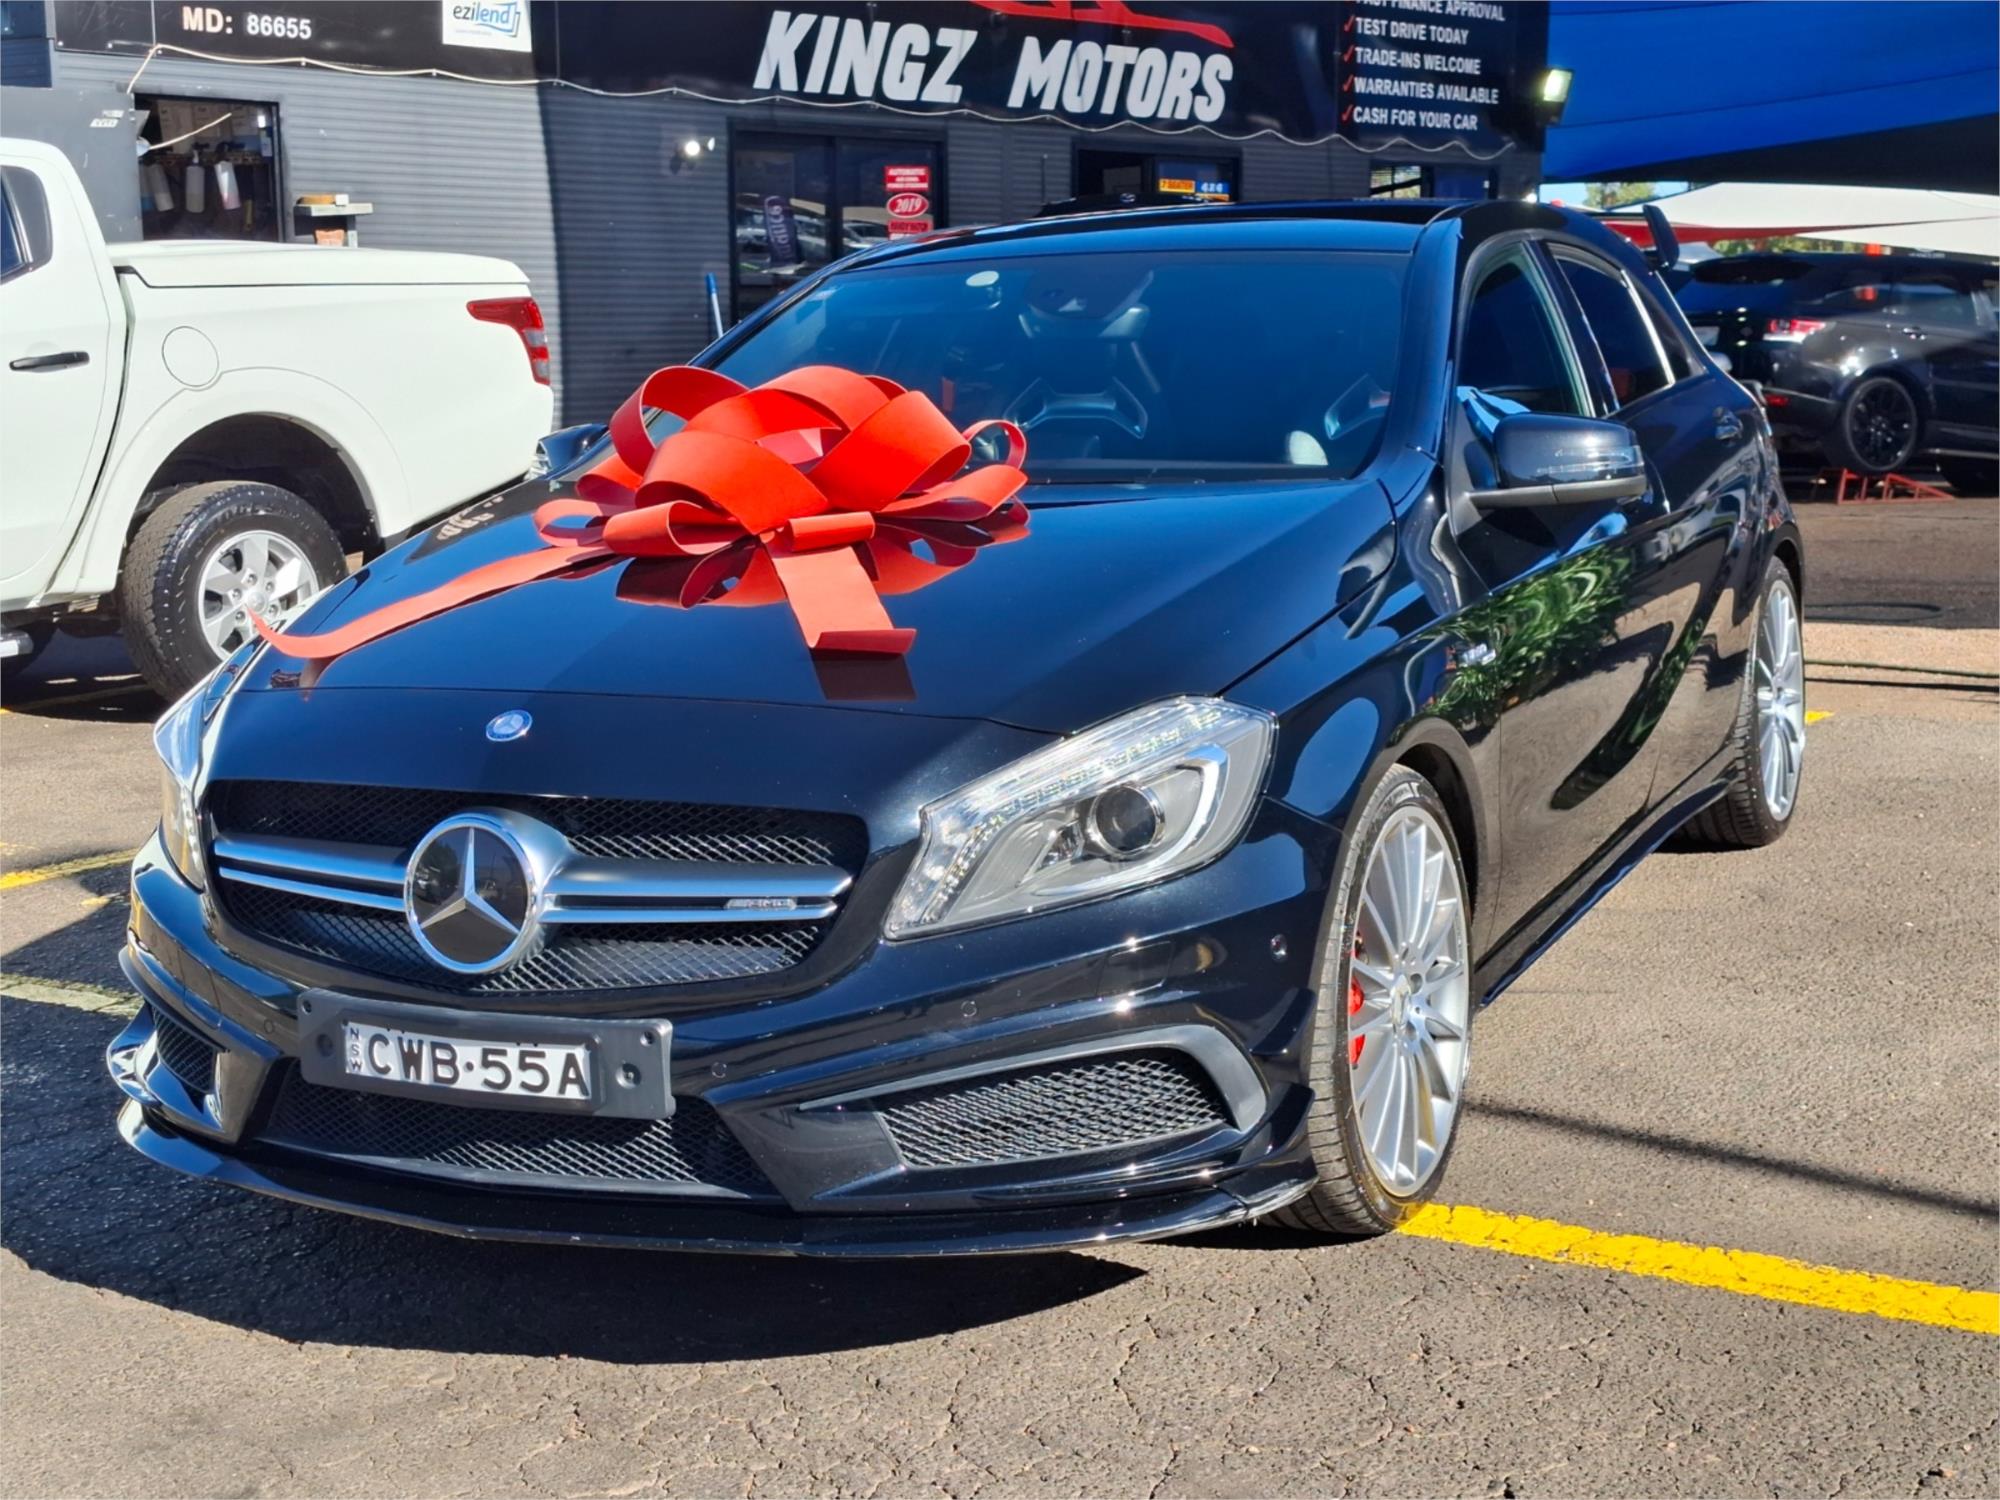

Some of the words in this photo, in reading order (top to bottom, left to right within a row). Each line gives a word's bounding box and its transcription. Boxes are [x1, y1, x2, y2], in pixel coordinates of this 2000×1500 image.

[182, 6, 233, 34] MD:
[246, 13, 312, 40] 86655
[453, 1, 512, 24] ezilend
[1445, 0, 1506, 21] APPROVAL
[1355, 17, 1388, 36] TEST
[1390, 21, 1427, 41] DRIVE
[1429, 25, 1469, 45] TODAY
[753, 10, 978, 104] KINGZ
[1007, 36, 1234, 122] MOTORS
[1354, 47, 1421, 70] TRADE-INS
[1423, 54, 1481, 75] WELCOME
[1354, 77, 1434, 99] WARRANTIES
[1436, 84, 1499, 104] AVAILABLE
[1353, 106, 1388, 124] CASH
[1390, 109, 1416, 127] FOR
[1418, 112, 1452, 129] YOUR
[1453, 114, 1478, 131] CAR
[893, 197, 922, 213] 2019
